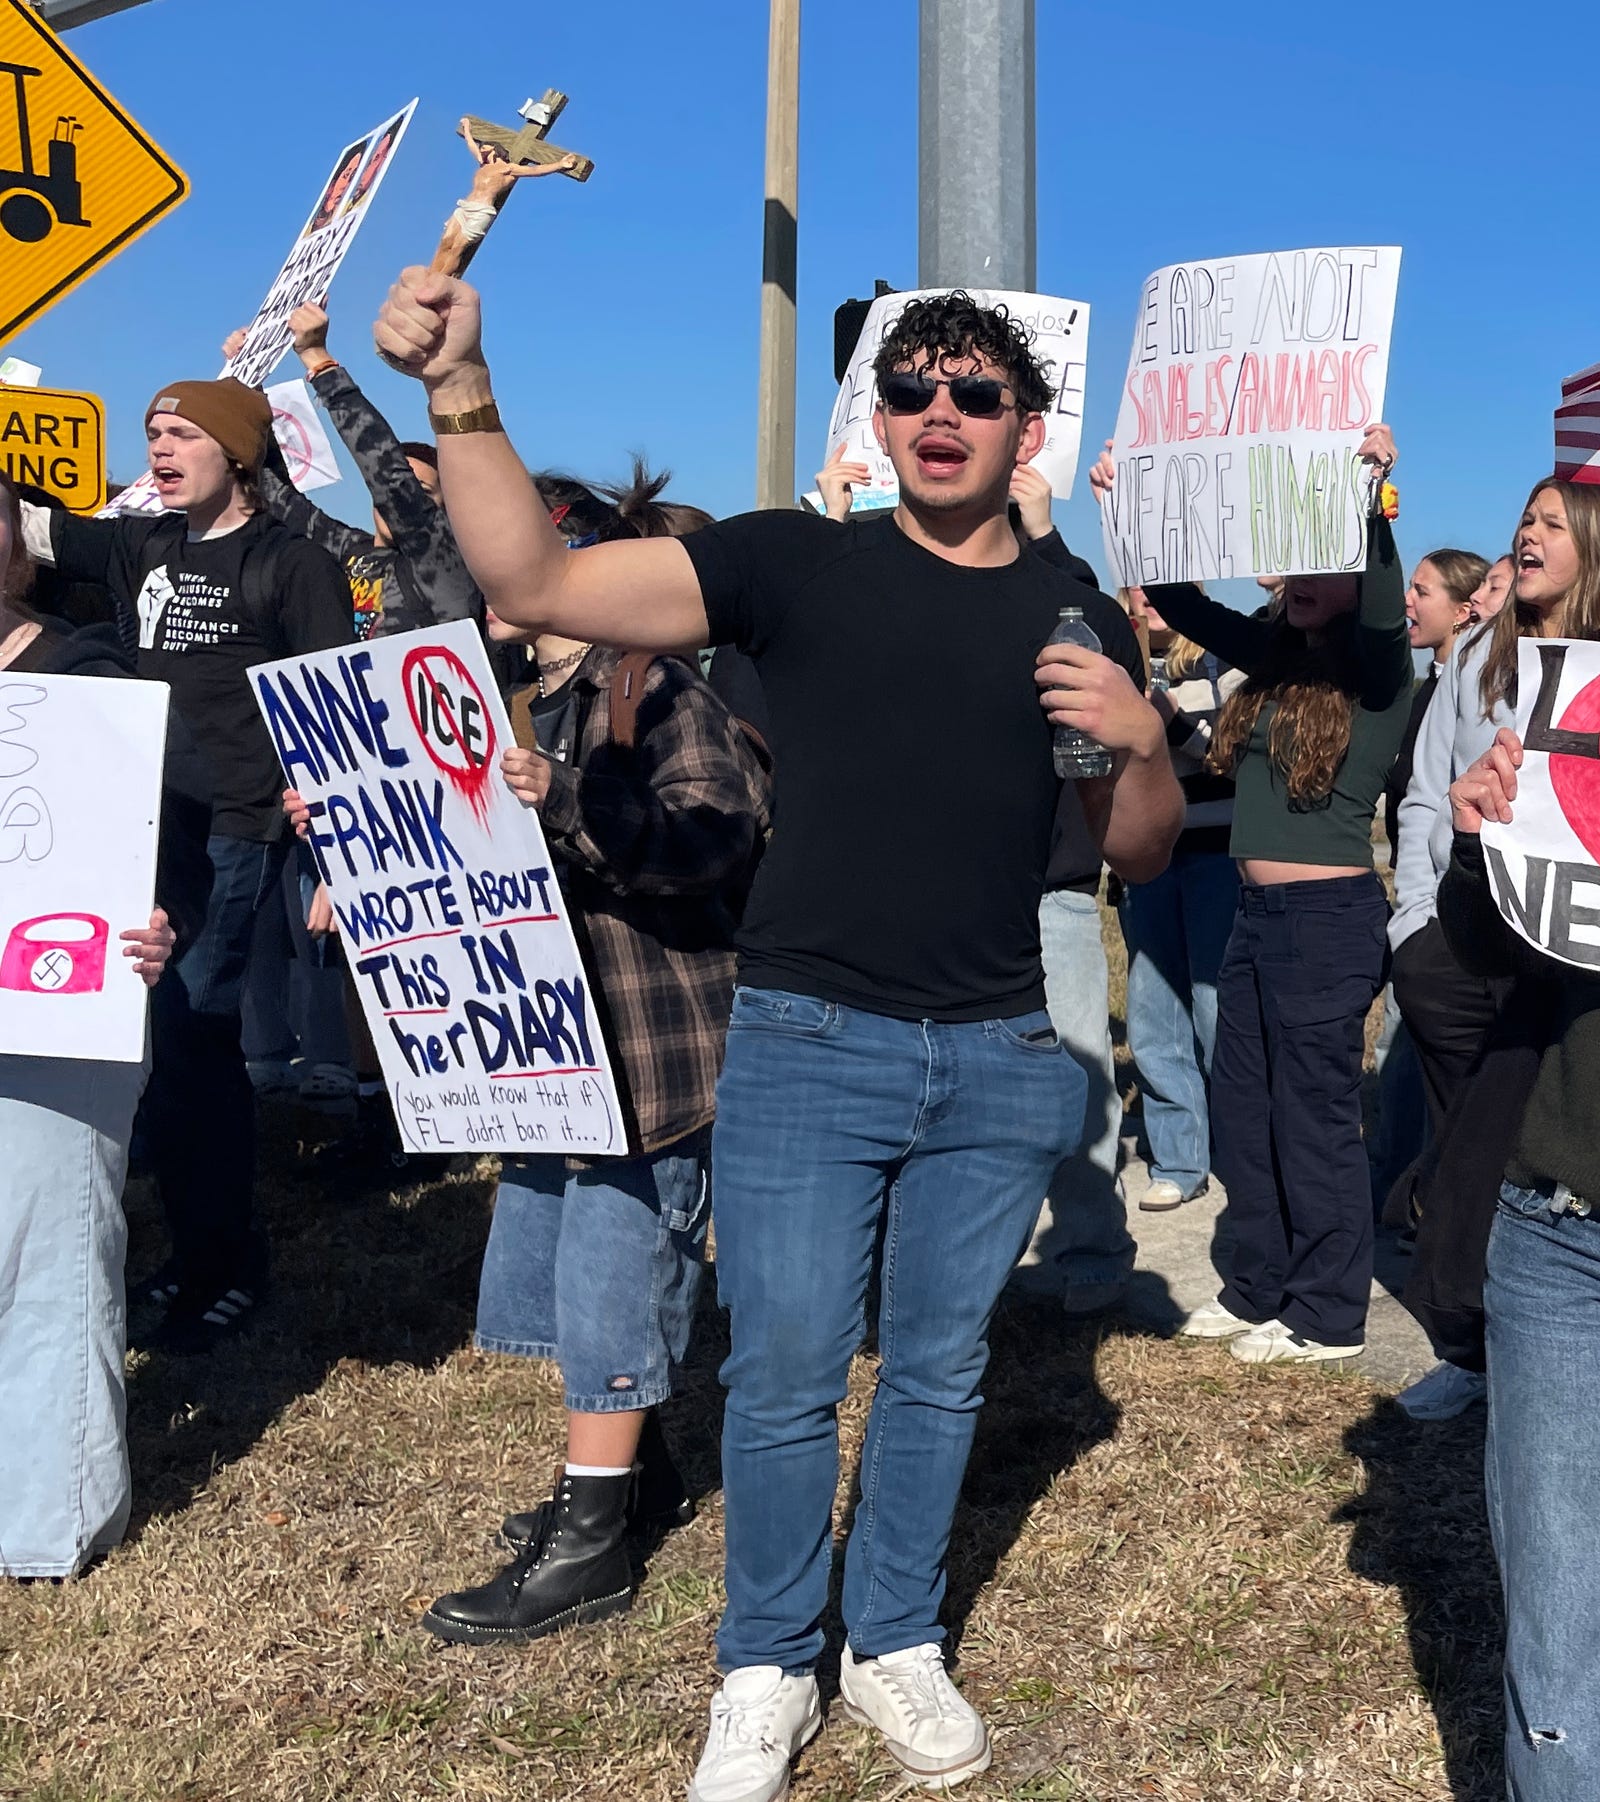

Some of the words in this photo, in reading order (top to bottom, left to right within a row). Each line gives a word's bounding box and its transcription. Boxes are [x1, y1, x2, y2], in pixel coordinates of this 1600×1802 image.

[1133, 276, 1159, 366] E
[1169, 265, 1235, 355] ARE
[1250, 249, 1378, 344] NOT
[1101, 455, 1159, 588] WE
[1161, 452, 1235, 580] ARE
[1248, 444, 1369, 573] HUMANS
[166, 616, 239, 634] RESISTANCE
[172, 595, 223, 608] BECOMES
[162, 640, 188, 652] DUTY
[165, 629, 219, 643] BECOMES
[257, 651, 410, 790] ANNE
[418, 672, 485, 765] ICE
[306, 779, 464, 886] FRANK
[334, 874, 463, 948] WROTE
[465, 867, 552, 925] ABOUT
[460, 929, 526, 995] IN
[389, 1017, 468, 1078] her
[464, 974, 596, 1073] DIARY
[439, 1084, 481, 1108] would
[536, 1079, 570, 1108] that
[416, 1116, 455, 1146] FL
[466, 1113, 507, 1145] didn't
[512, 1111, 548, 1142] ban
